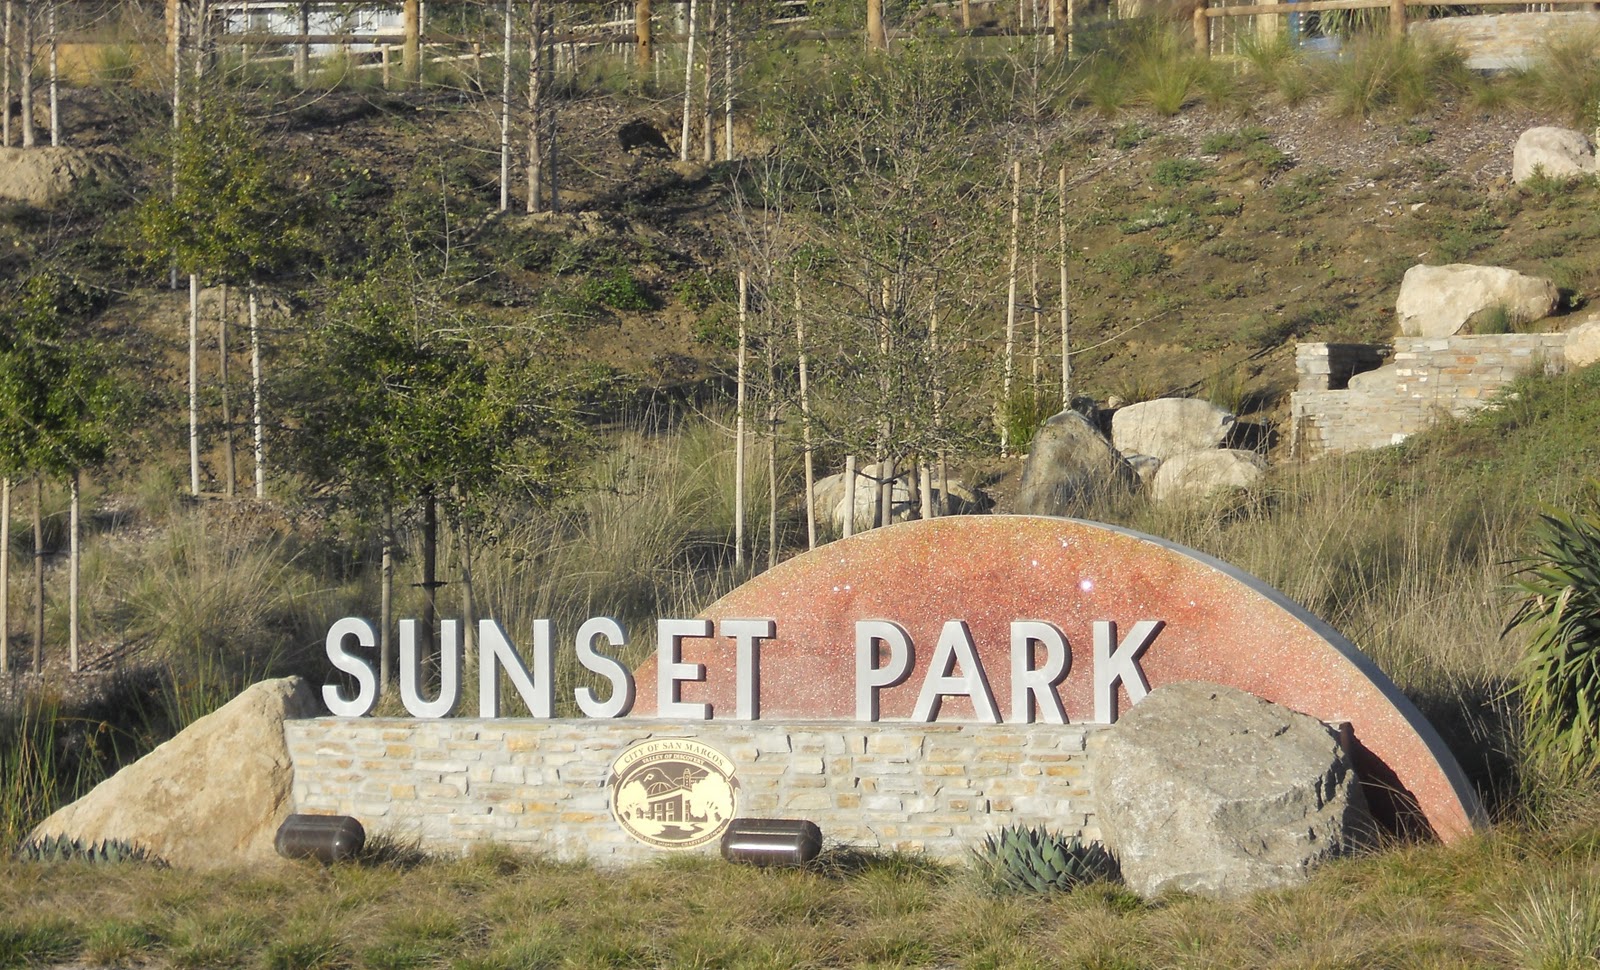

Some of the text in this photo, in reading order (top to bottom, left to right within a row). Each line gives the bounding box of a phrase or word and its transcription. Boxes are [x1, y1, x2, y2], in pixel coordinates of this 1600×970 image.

[322, 617, 1166, 725] SUNSET PARK
[624, 748, 643, 763] CITY
[685, 743, 724, 766] MARCOS
[642, 754, 663, 763] VALLEY
[673, 754, 704, 765] DISCOVERY
